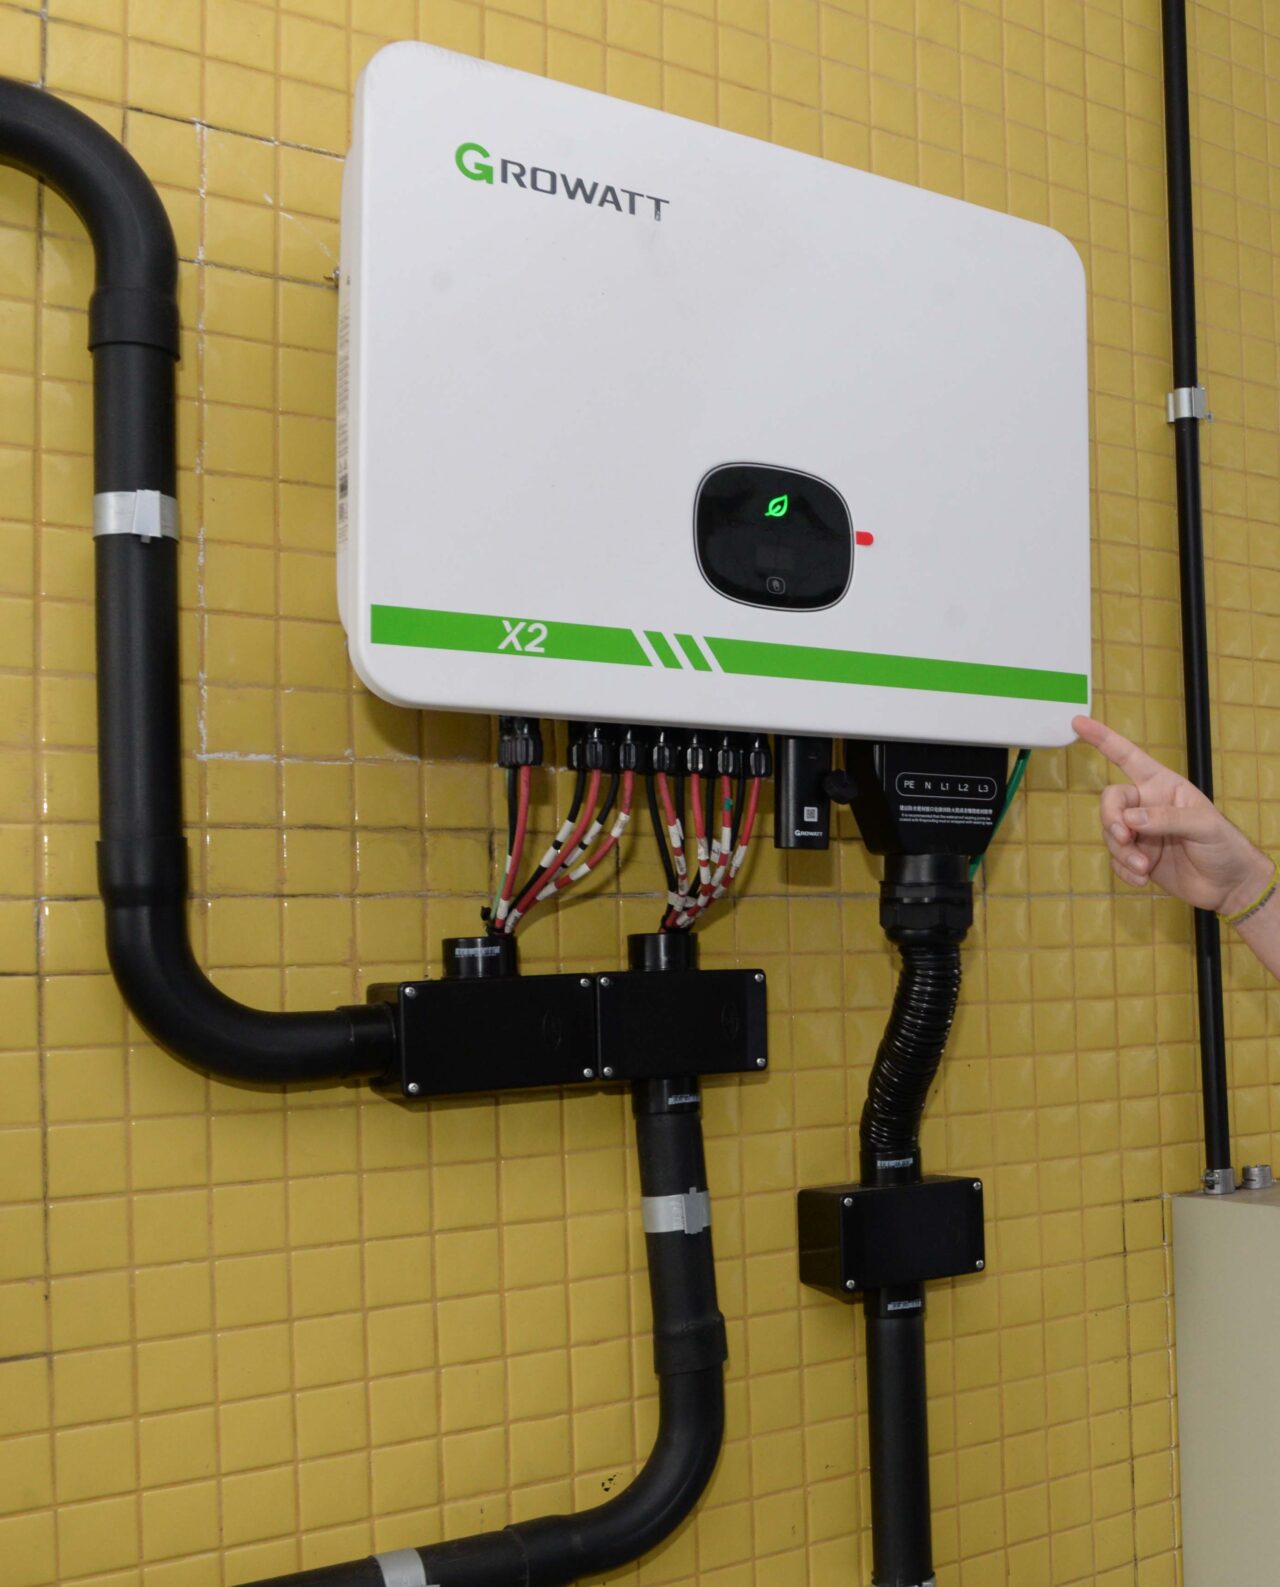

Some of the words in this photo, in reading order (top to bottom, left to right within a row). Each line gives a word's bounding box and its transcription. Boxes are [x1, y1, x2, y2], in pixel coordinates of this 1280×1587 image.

[455, 142, 670, 222] GROWATT
[497, 619, 548, 653] X2
[904, 780, 915, 789] PE
[924, 781, 932, 790] N
[941, 782, 949, 791] L1
[958, 783, 969, 792] L2
[978, 784, 989, 793] L3
